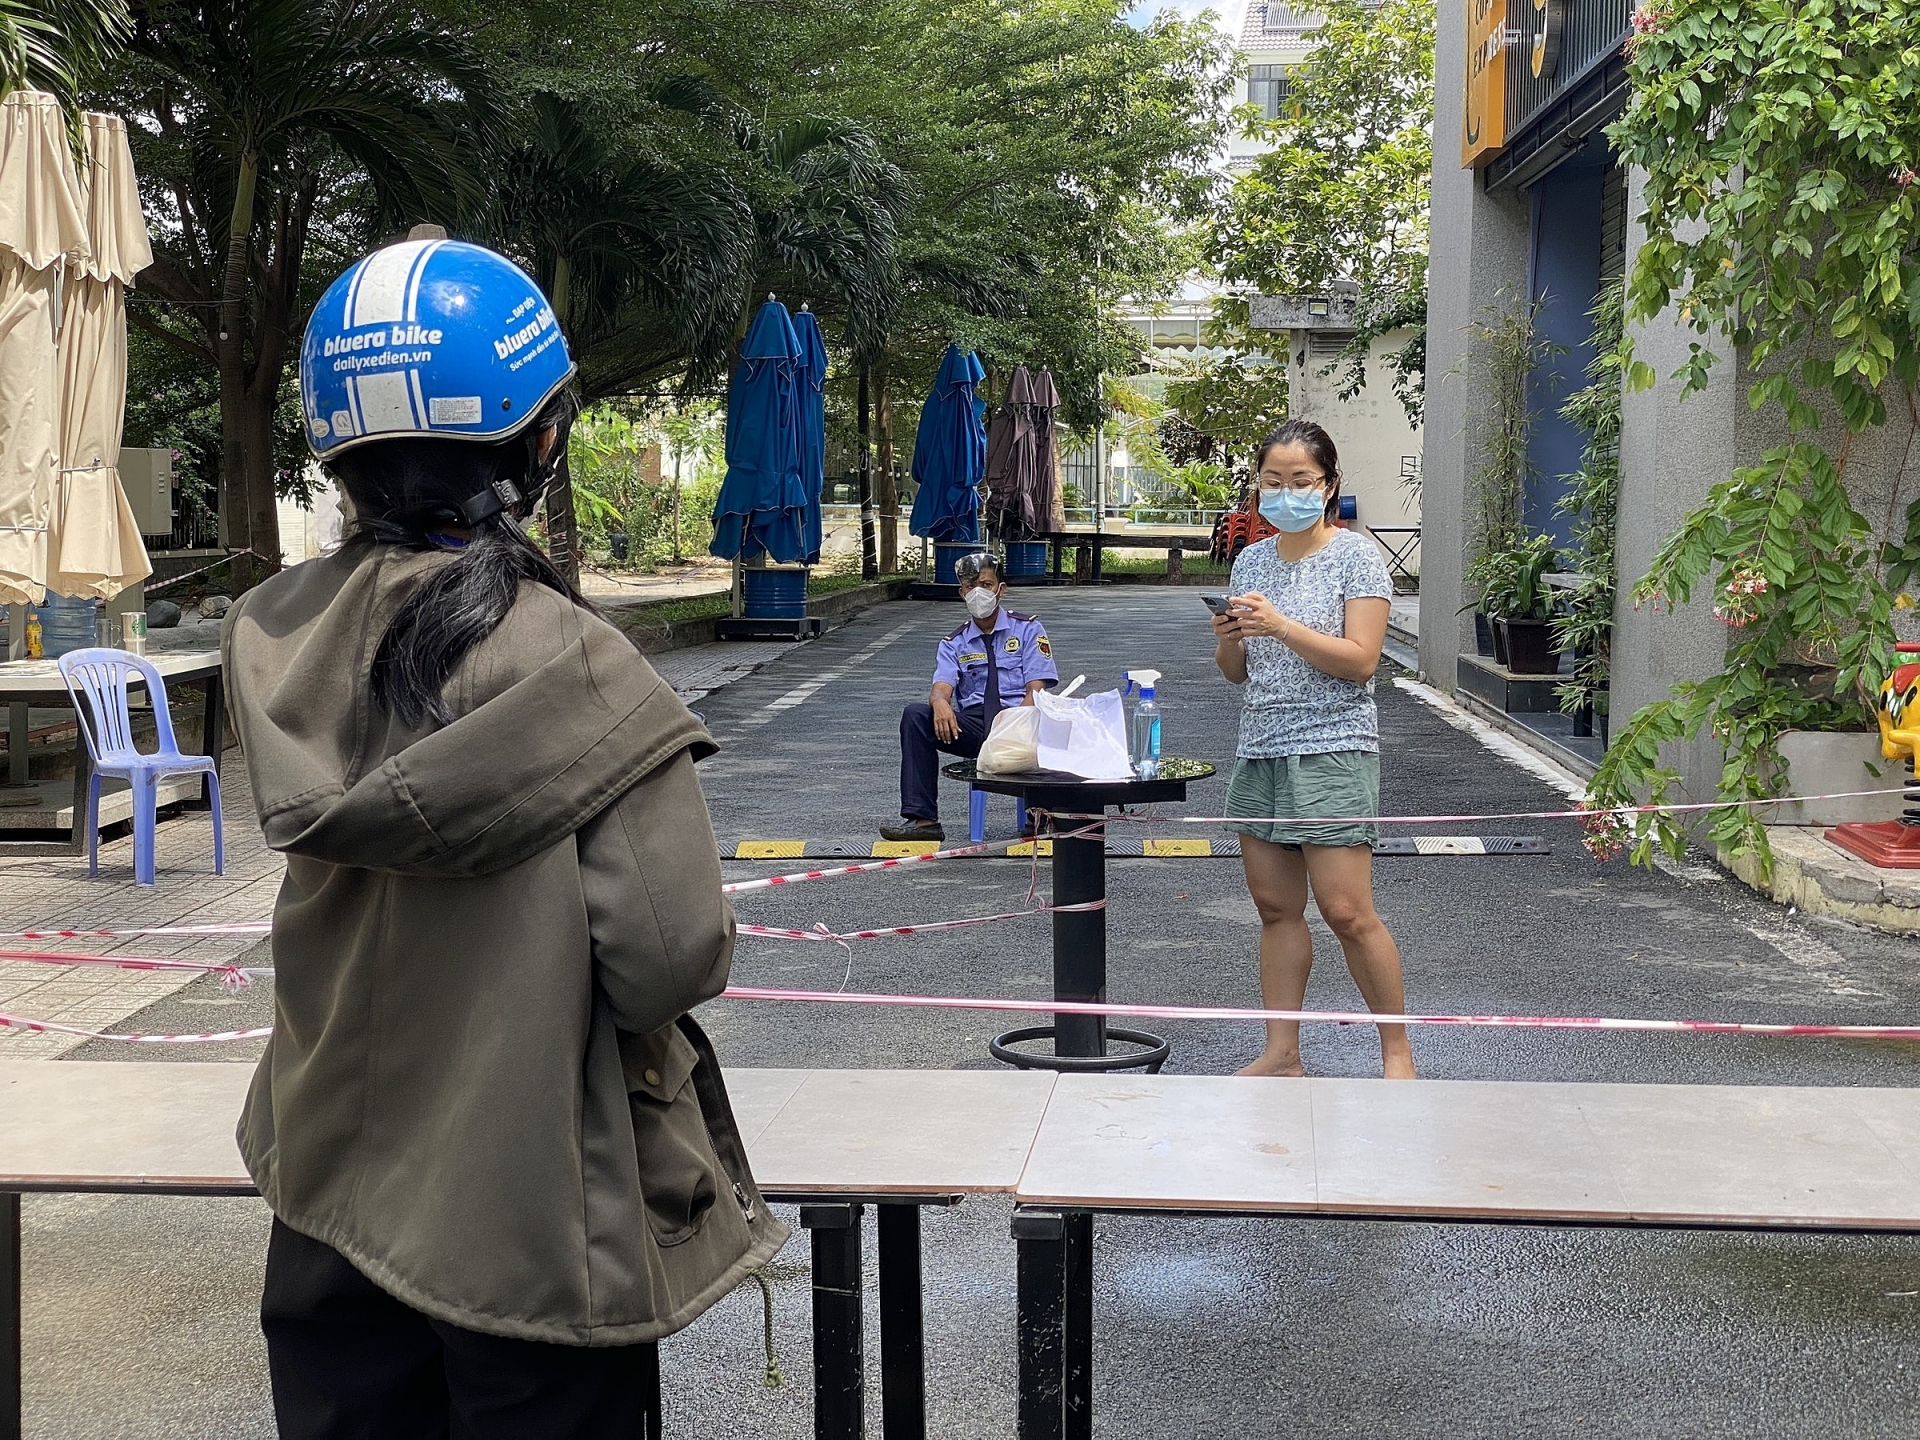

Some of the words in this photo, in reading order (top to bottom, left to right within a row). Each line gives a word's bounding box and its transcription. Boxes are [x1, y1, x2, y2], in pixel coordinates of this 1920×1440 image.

[324, 331, 386, 357] bluera
[392, 325, 443, 345] bike
[494, 321, 541, 360] bluera
[333, 351, 432, 372] dailyxedien.vn
